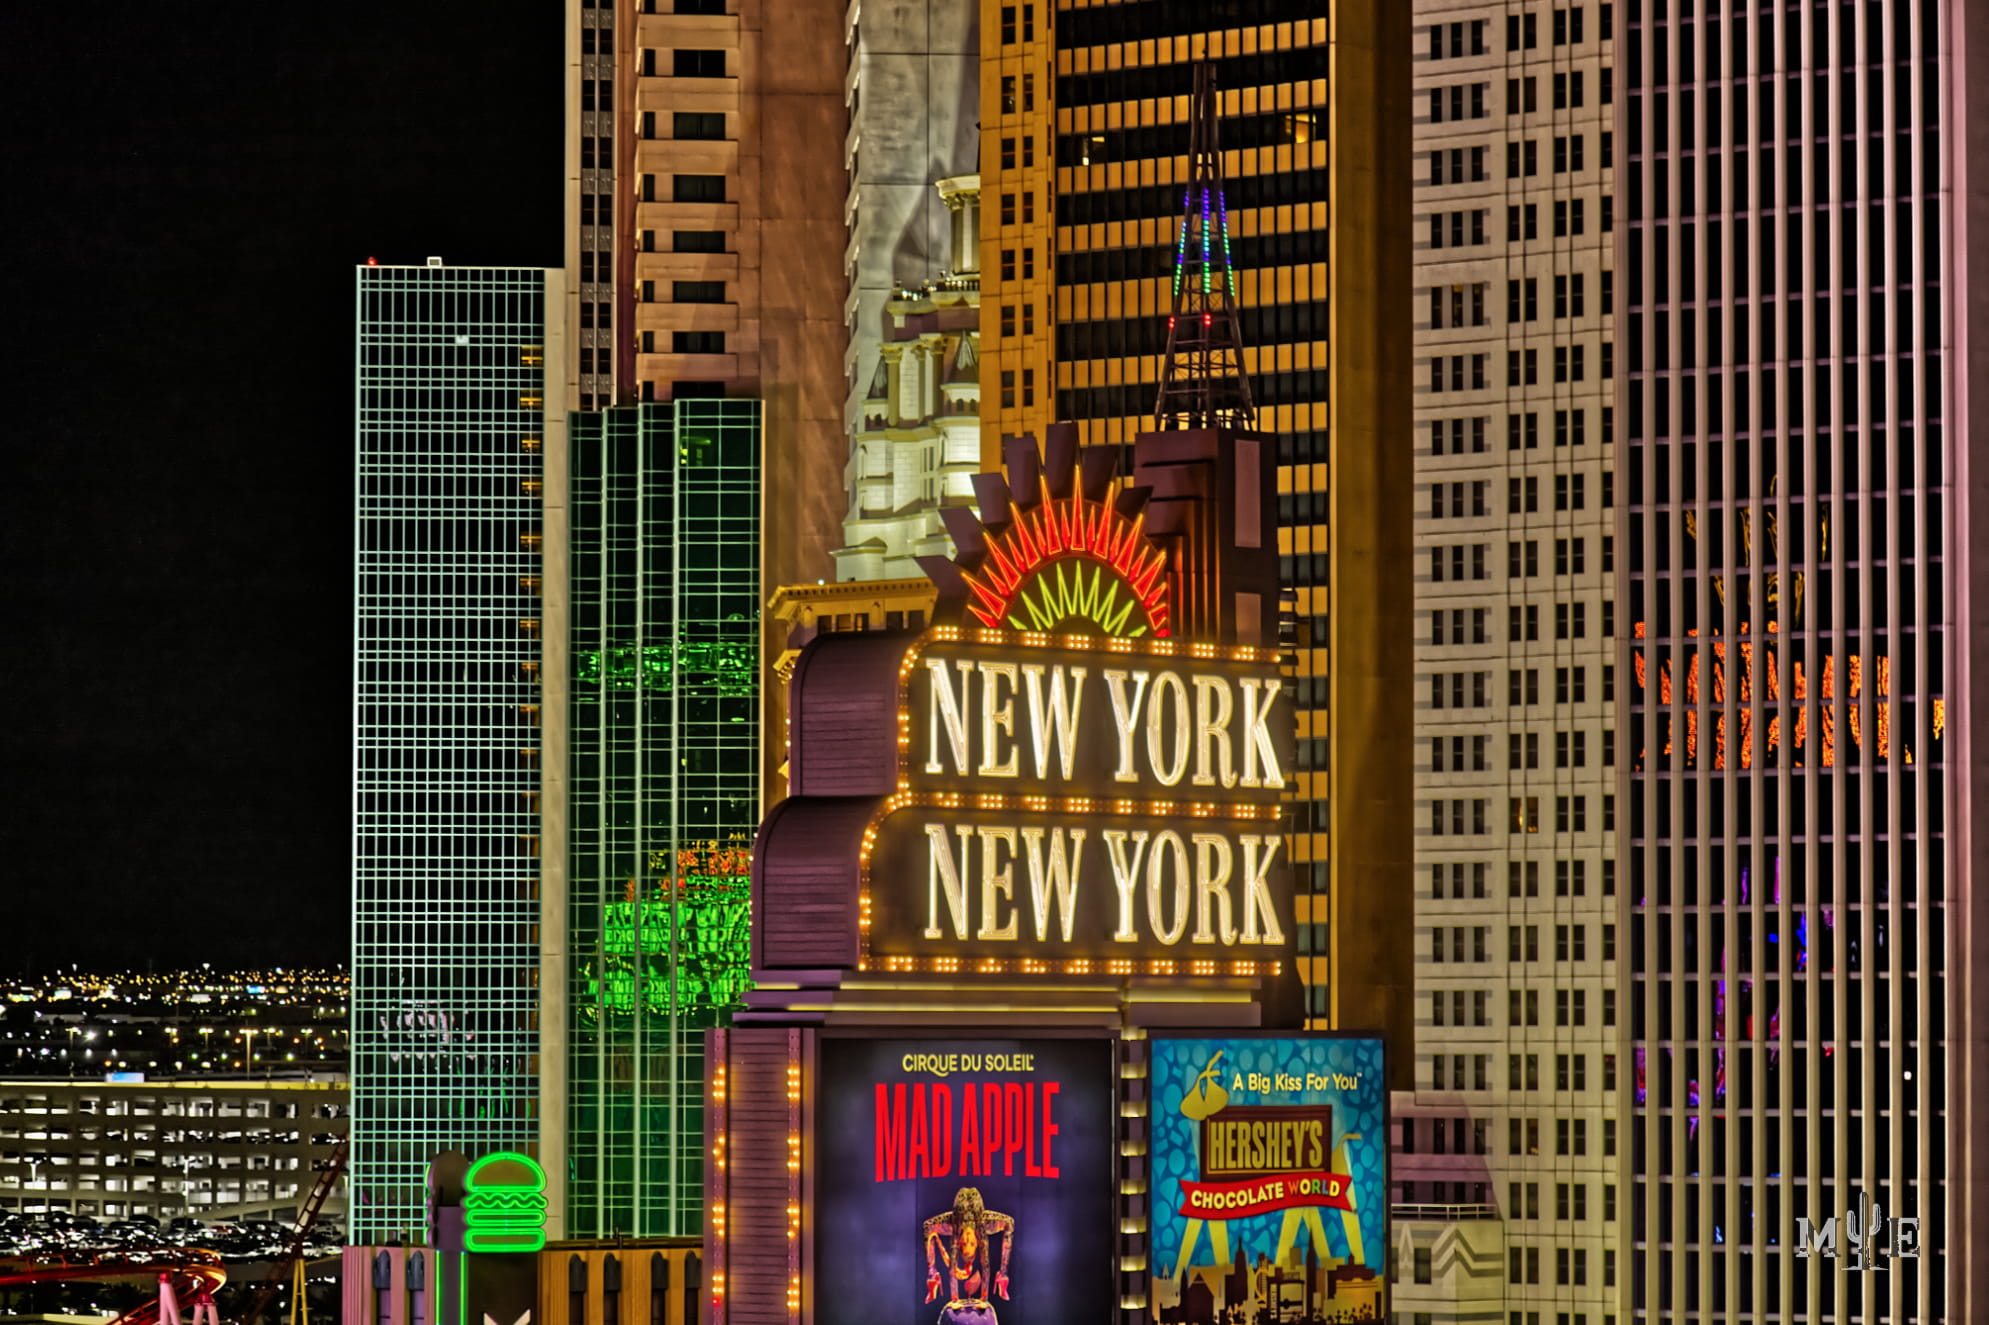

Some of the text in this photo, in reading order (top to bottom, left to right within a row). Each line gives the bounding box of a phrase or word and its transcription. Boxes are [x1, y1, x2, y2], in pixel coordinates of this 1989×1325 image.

[925, 657, 1286, 789] NEW YORK
[924, 823, 1286, 946] NEW YORK
[902, 1053, 1034, 1077] CIRQUE DU SOLEIL
[1232, 1073, 1245, 1091] A
[1248, 1073, 1271, 1094] Big
[1275, 1073, 1302, 1091] Kiss
[1306, 1073, 1329, 1091] For
[875, 1081, 1060, 1183] MAD APPLE
[1210, 1120, 1323, 1169] HERSHEY'S
[1191, 1178, 1340, 1210] CHOCOLATE WORLD
